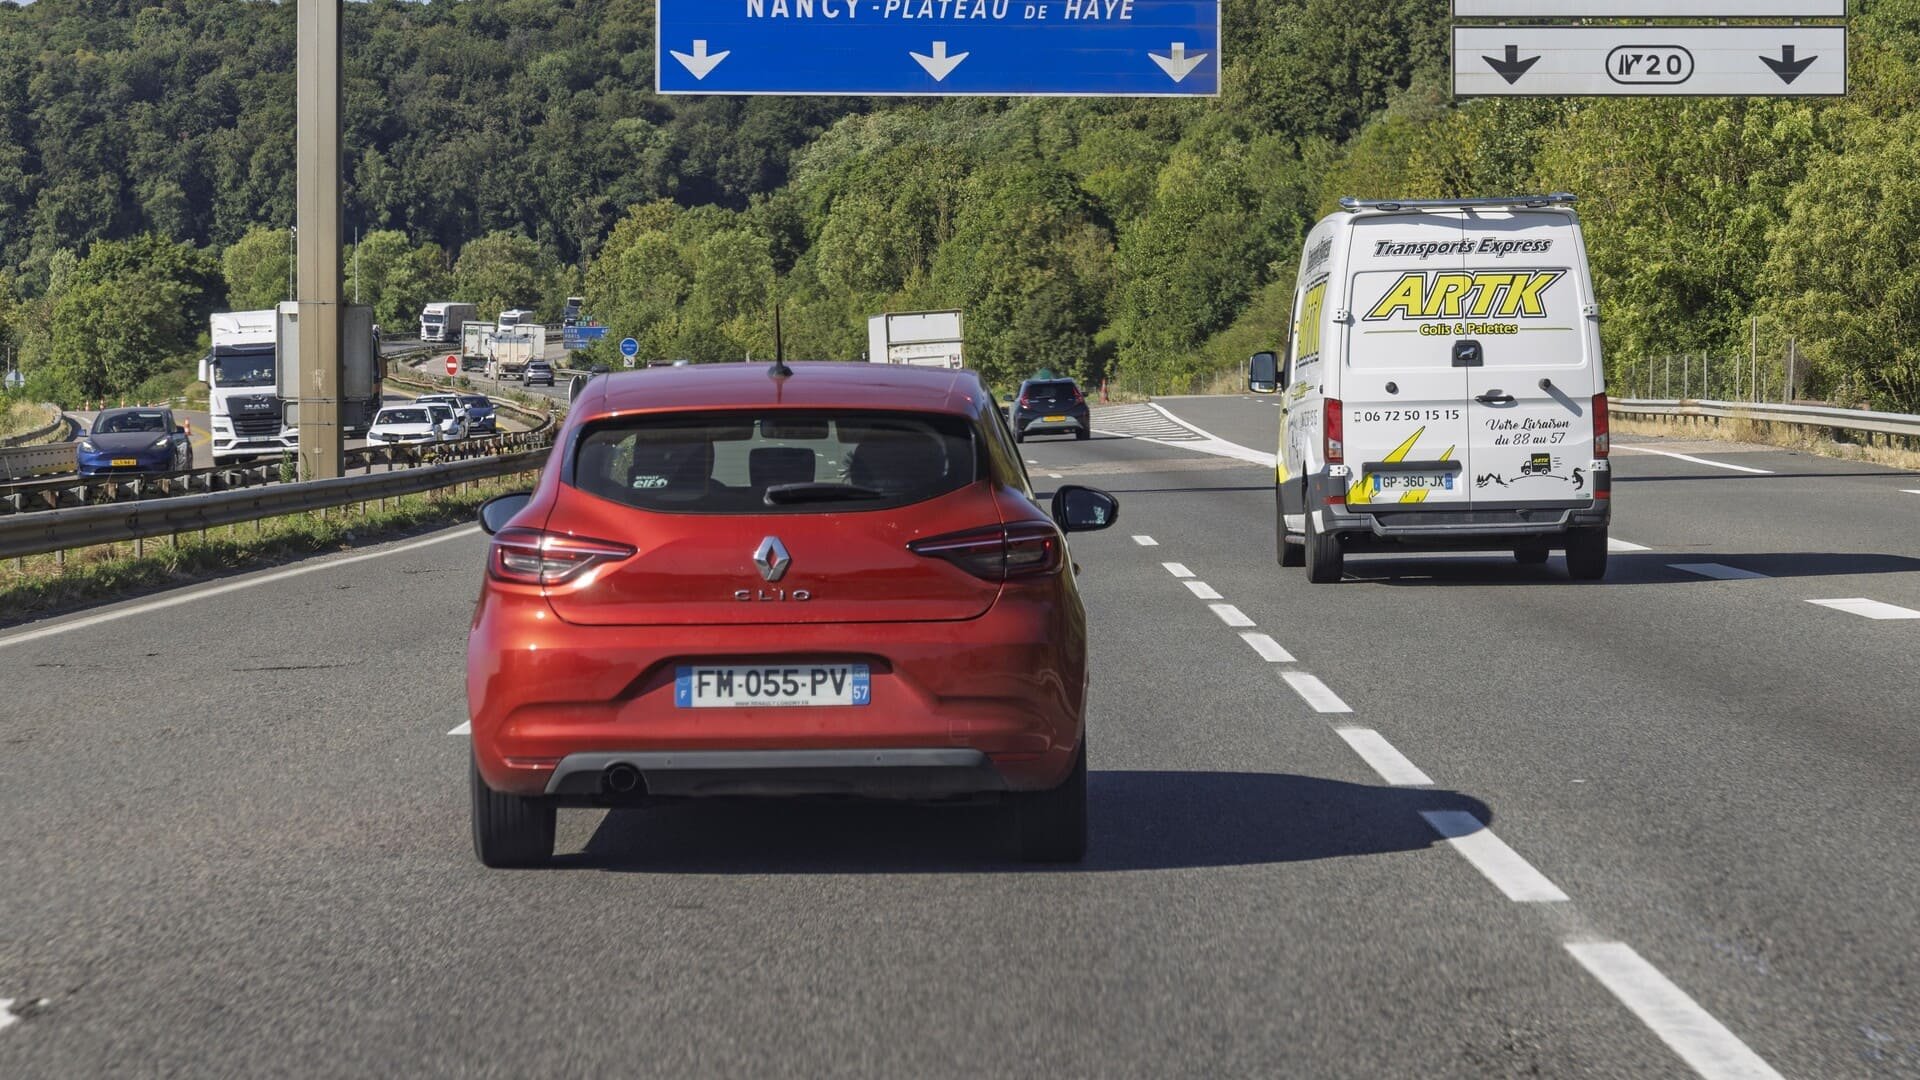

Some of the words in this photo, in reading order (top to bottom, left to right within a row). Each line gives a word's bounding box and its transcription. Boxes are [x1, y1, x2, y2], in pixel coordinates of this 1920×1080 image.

[746, 0, 862, 19] NANCY
[1023, 5, 1048, 20] DE
[1064, 0, 1135, 21] HAYE
[1646, 54, 1682, 76] 20
[1373, 239, 1475, 260] Transports
[1475, 237, 1553, 259] Express
[1362, 269, 1568, 321] ARTK
[1419, 324, 1450, 336] Colis
[1454, 323, 1465, 335] &
[1467, 322, 1519, 335] Palettes
[1364, 411, 1381, 422] 06
[1384, 410, 1401, 422] 72
[1404, 410, 1420, 421] 50
[1425, 410, 1440, 421] 15
[1445, 409, 1460, 420] 15
[1485, 418, 1519, 431] Votre
[1521, 417, 1570, 431] Livraison
[1494, 434, 1510, 446] du
[1512, 432, 1531, 446] 88
[1532, 436, 1547, 445] au
[1550, 432, 1566, 444] 57
[734, 589, 810, 601] CLIO
[698, 668, 848, 698] FM-055-PV
[680, 690, 687, 699] F
[853, 685, 869, 700] 57
